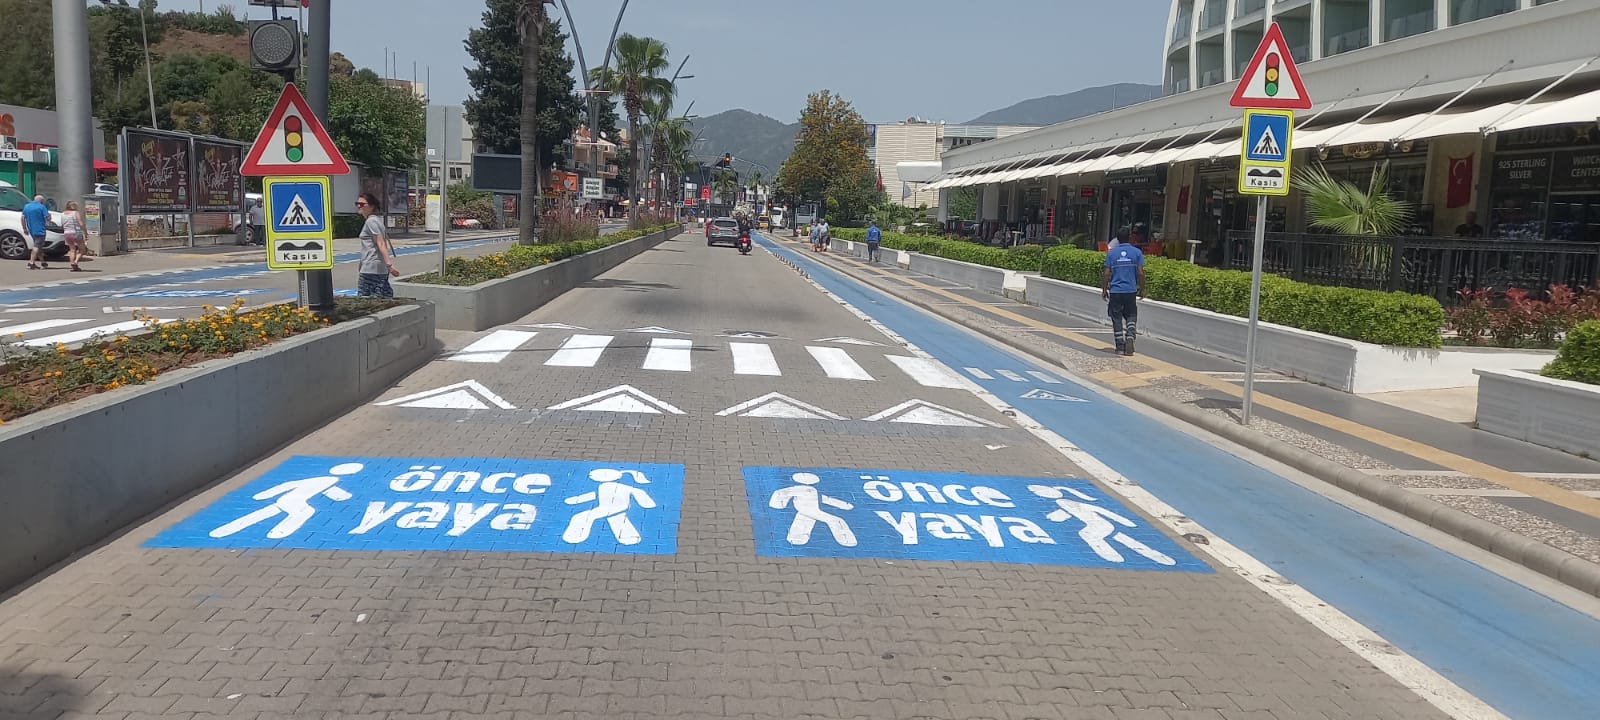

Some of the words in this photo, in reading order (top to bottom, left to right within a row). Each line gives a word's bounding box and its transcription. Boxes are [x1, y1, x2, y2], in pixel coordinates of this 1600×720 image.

[1512, 158, 1546, 168] STERLING
[1251, 178, 1278, 187] Kasis
[1509, 170, 1532, 179] SILVER
[283, 251, 318, 261] Kasis
[389, 465, 552, 494] önce
[859, 475, 1017, 508] önce
[348, 500, 537, 537] yaya
[873, 510, 1057, 548] yaya
